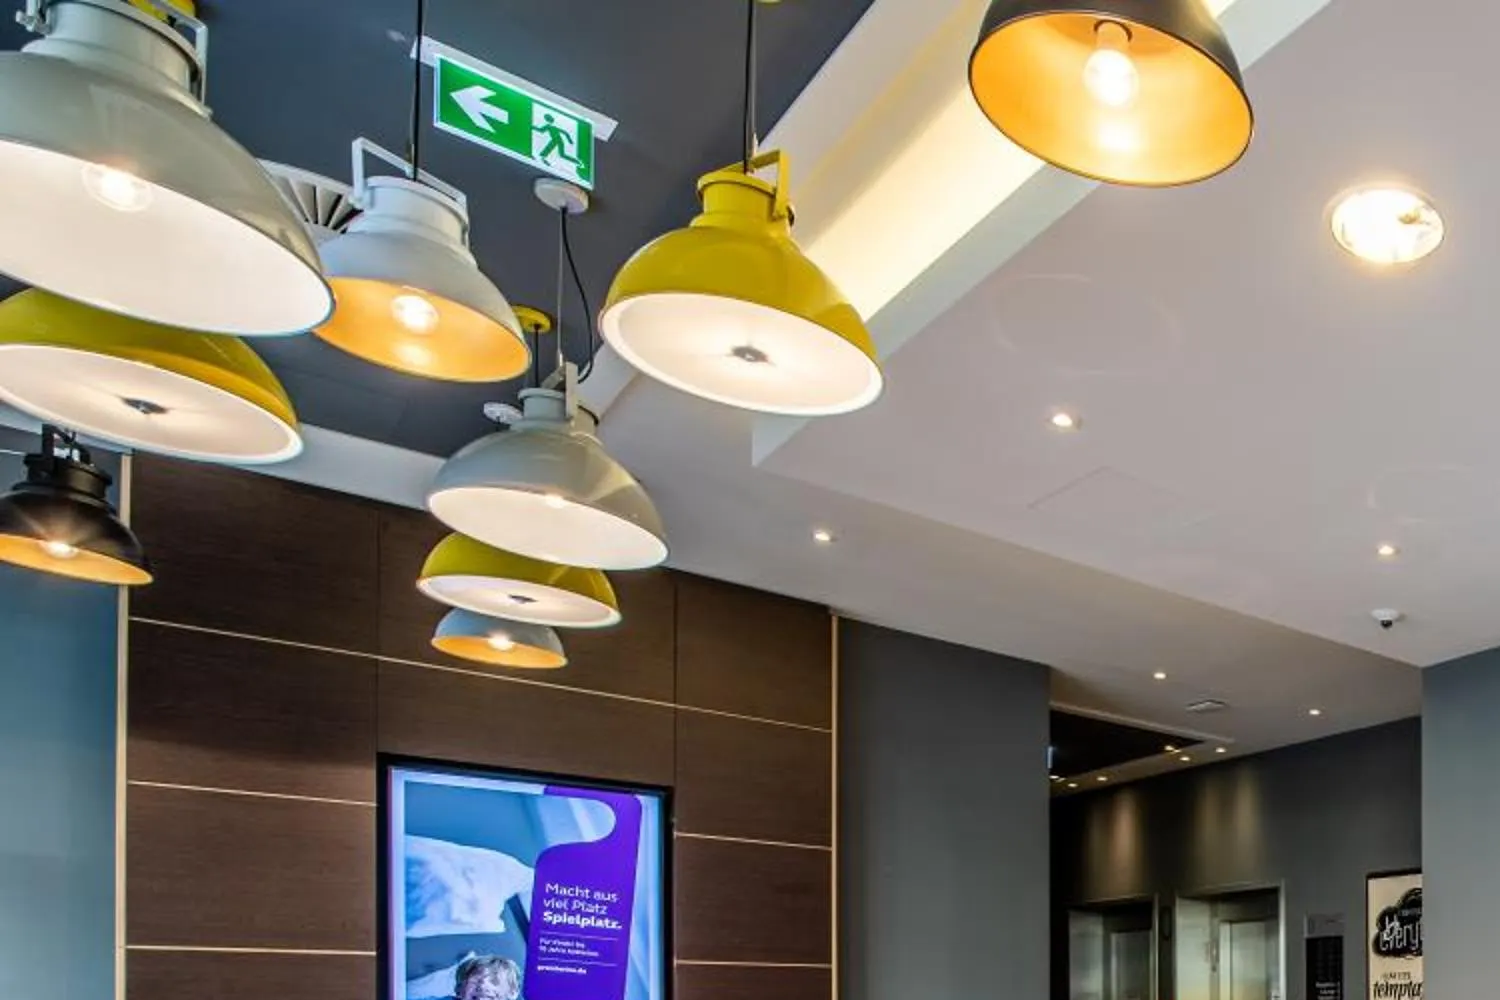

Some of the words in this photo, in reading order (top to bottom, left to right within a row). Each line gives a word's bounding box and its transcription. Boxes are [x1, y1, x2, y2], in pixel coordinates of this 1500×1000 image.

[545, 883, 591, 899] Macht
[593, 891, 618, 903] aus
[543, 911, 622, 929] Spielplatz.
